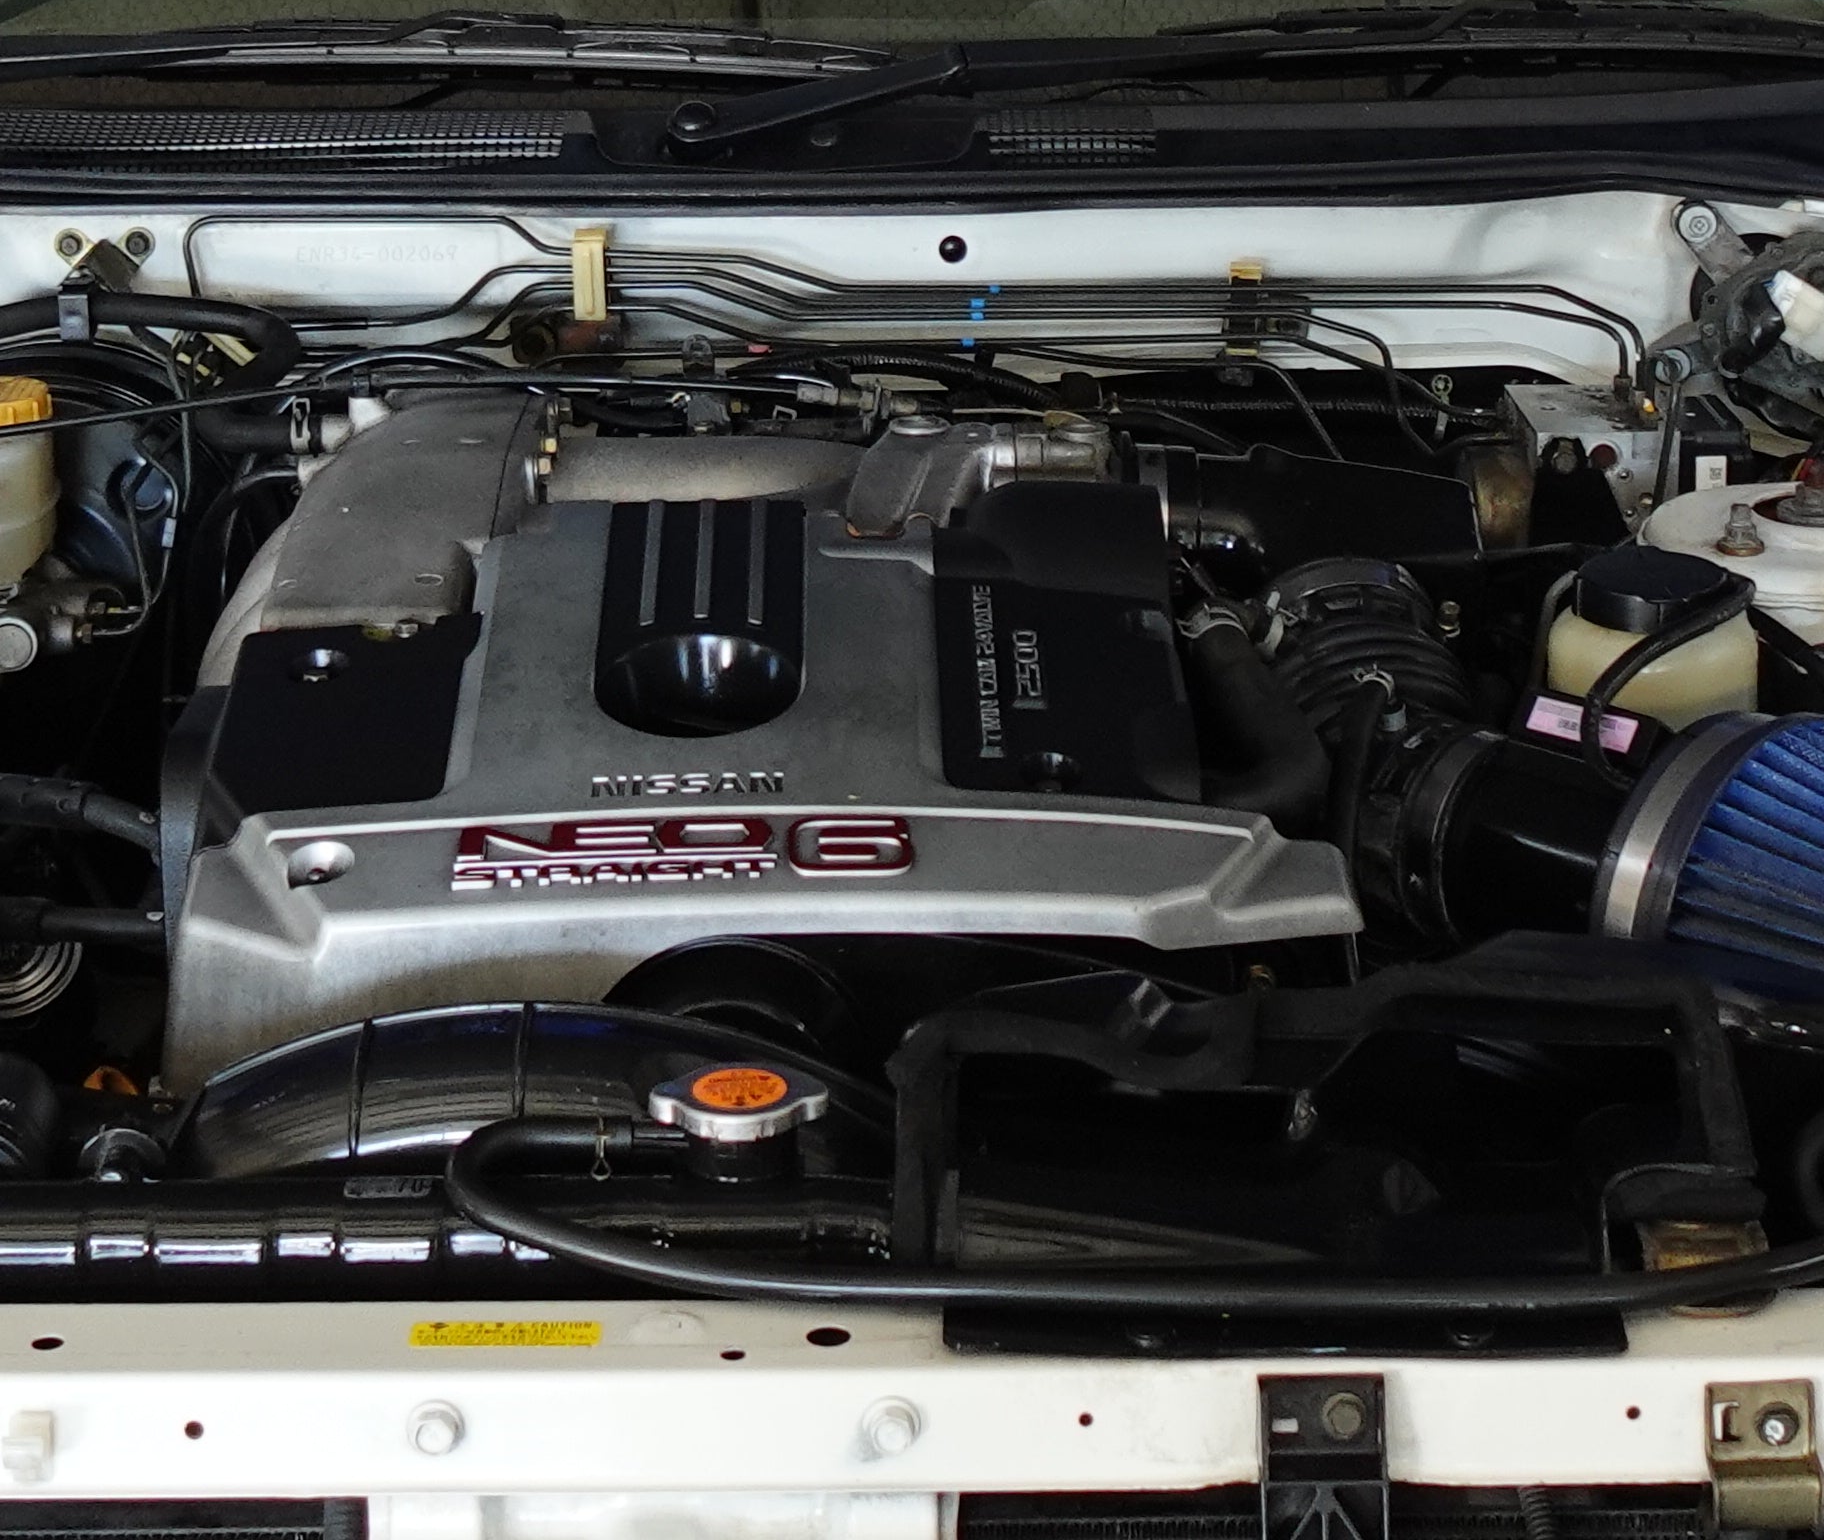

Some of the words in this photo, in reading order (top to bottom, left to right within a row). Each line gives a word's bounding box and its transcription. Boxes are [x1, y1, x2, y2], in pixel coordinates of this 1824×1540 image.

[976, 658, 998, 696] CAM
[590, 770, 785, 799] NISSAN
[450, 860, 778, 892] STRAIGHT
[786, 815, 914, 879] 6
[455, 818, 775, 859] NEO
[531, 1321, 593, 1329] CAUTION
